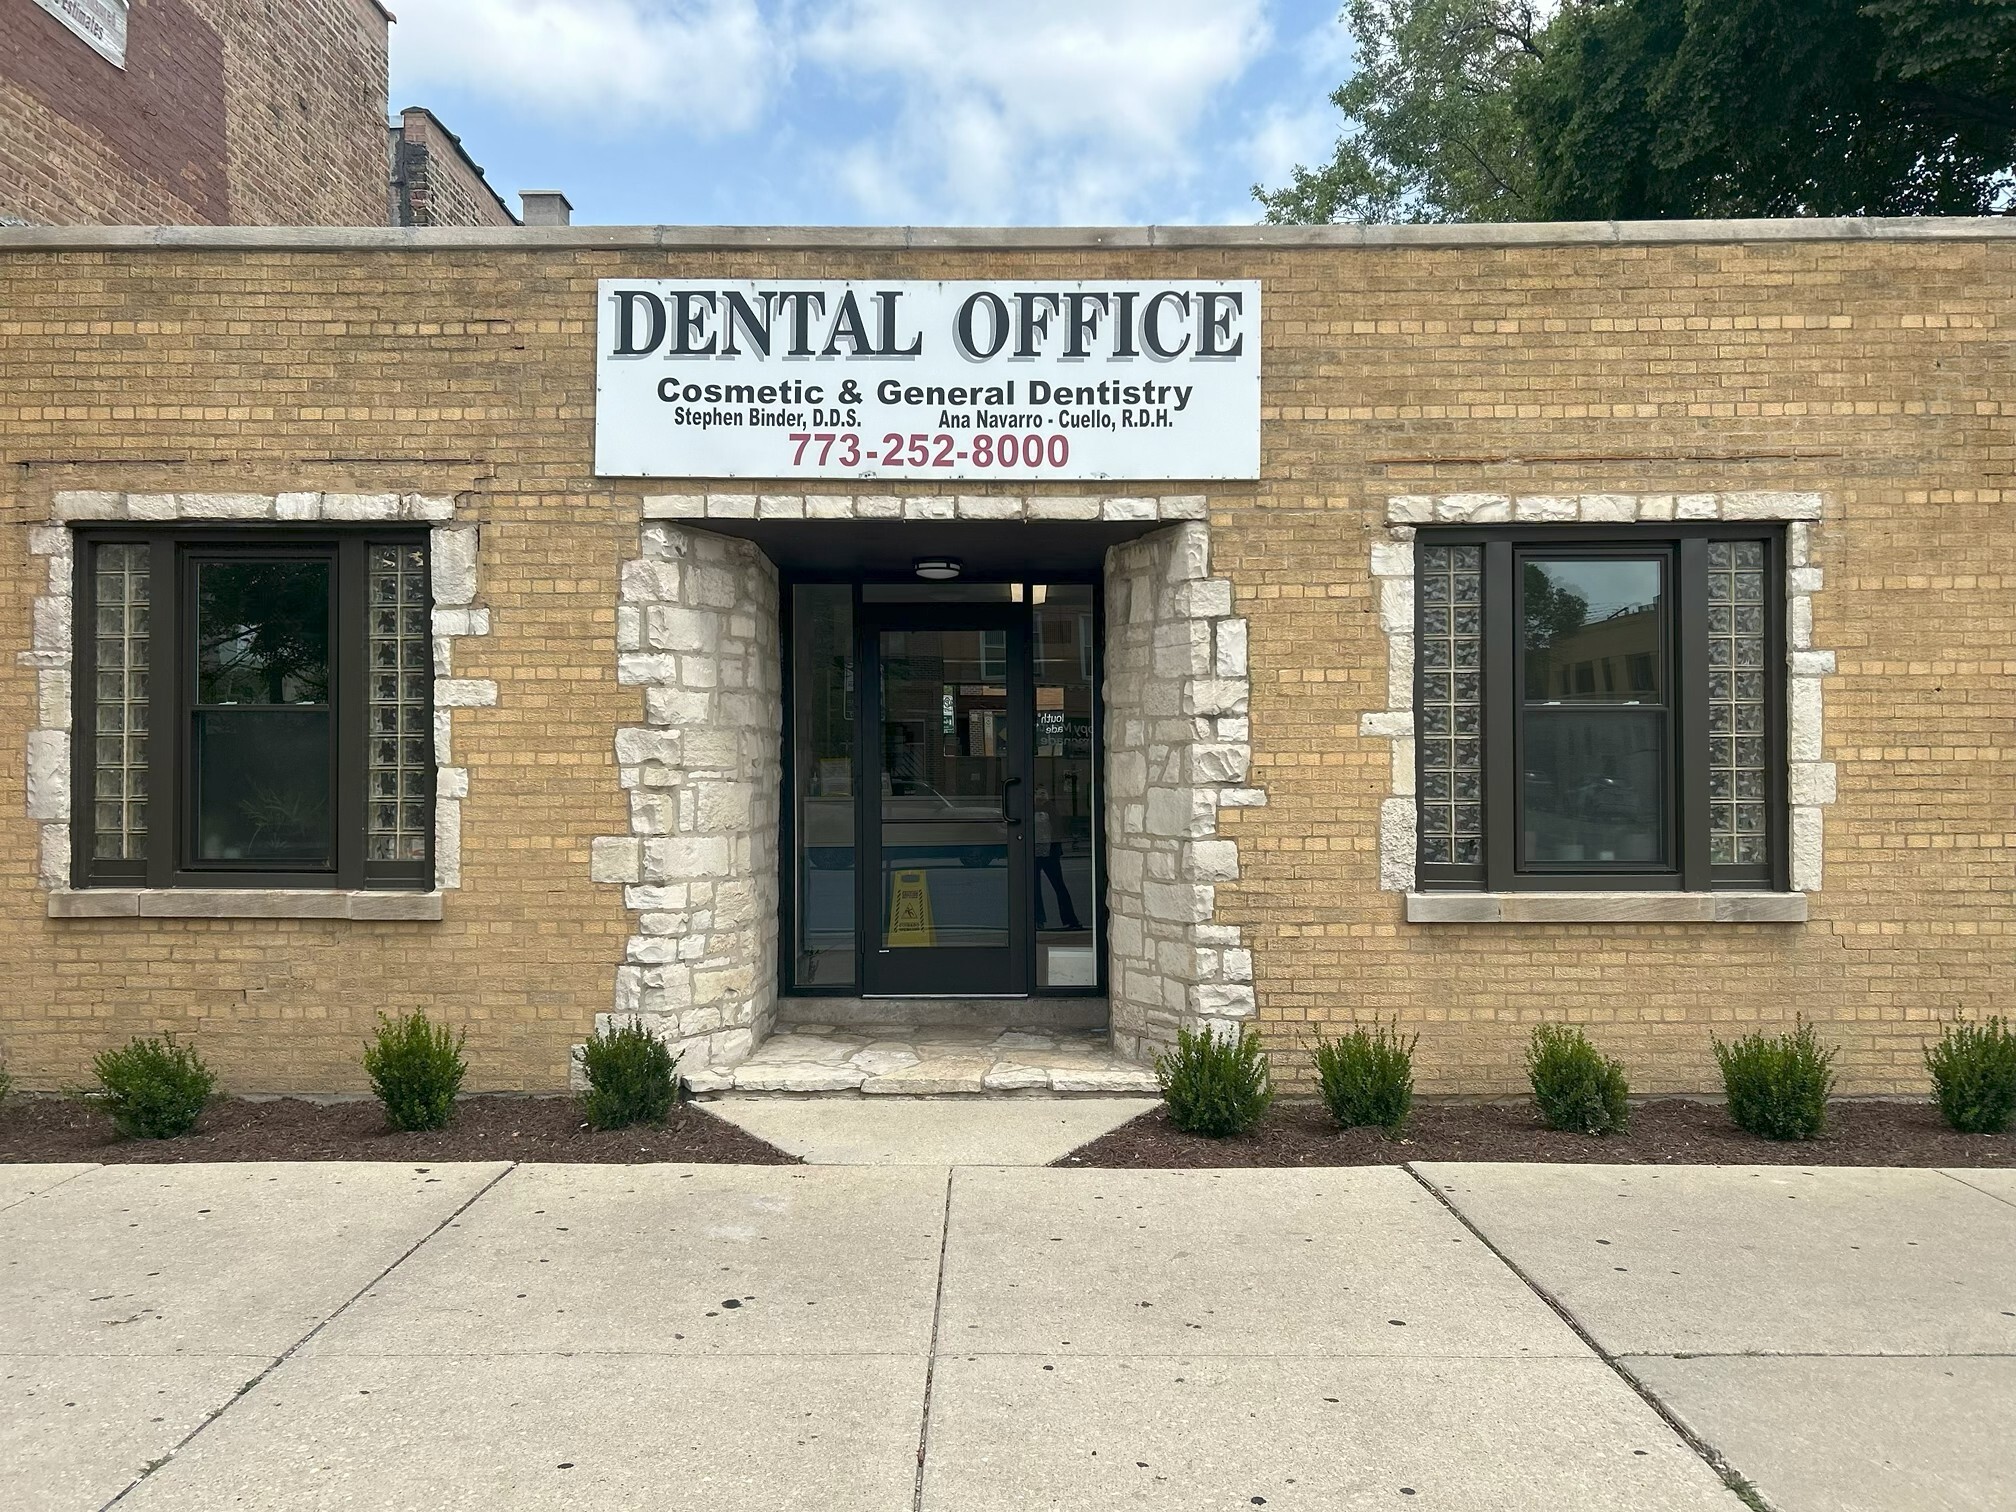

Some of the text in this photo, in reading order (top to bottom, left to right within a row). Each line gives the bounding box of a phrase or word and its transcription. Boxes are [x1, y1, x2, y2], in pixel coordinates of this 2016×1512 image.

[607, 290, 1244, 363] DENTAL OFFICE
[657, 377, 1193, 411] Cosmetic & General Dentistry
[674, 406, 862, 431] Stephen Binder, D.D.S.
[938, 409, 971, 429] Ana
[976, 409, 1043, 429] Navarro
[1058, 409, 1116, 432] Cuello,
[1122, 408, 1173, 428] R.D.H.
[789, 432, 1069, 468] 773-252-8000
